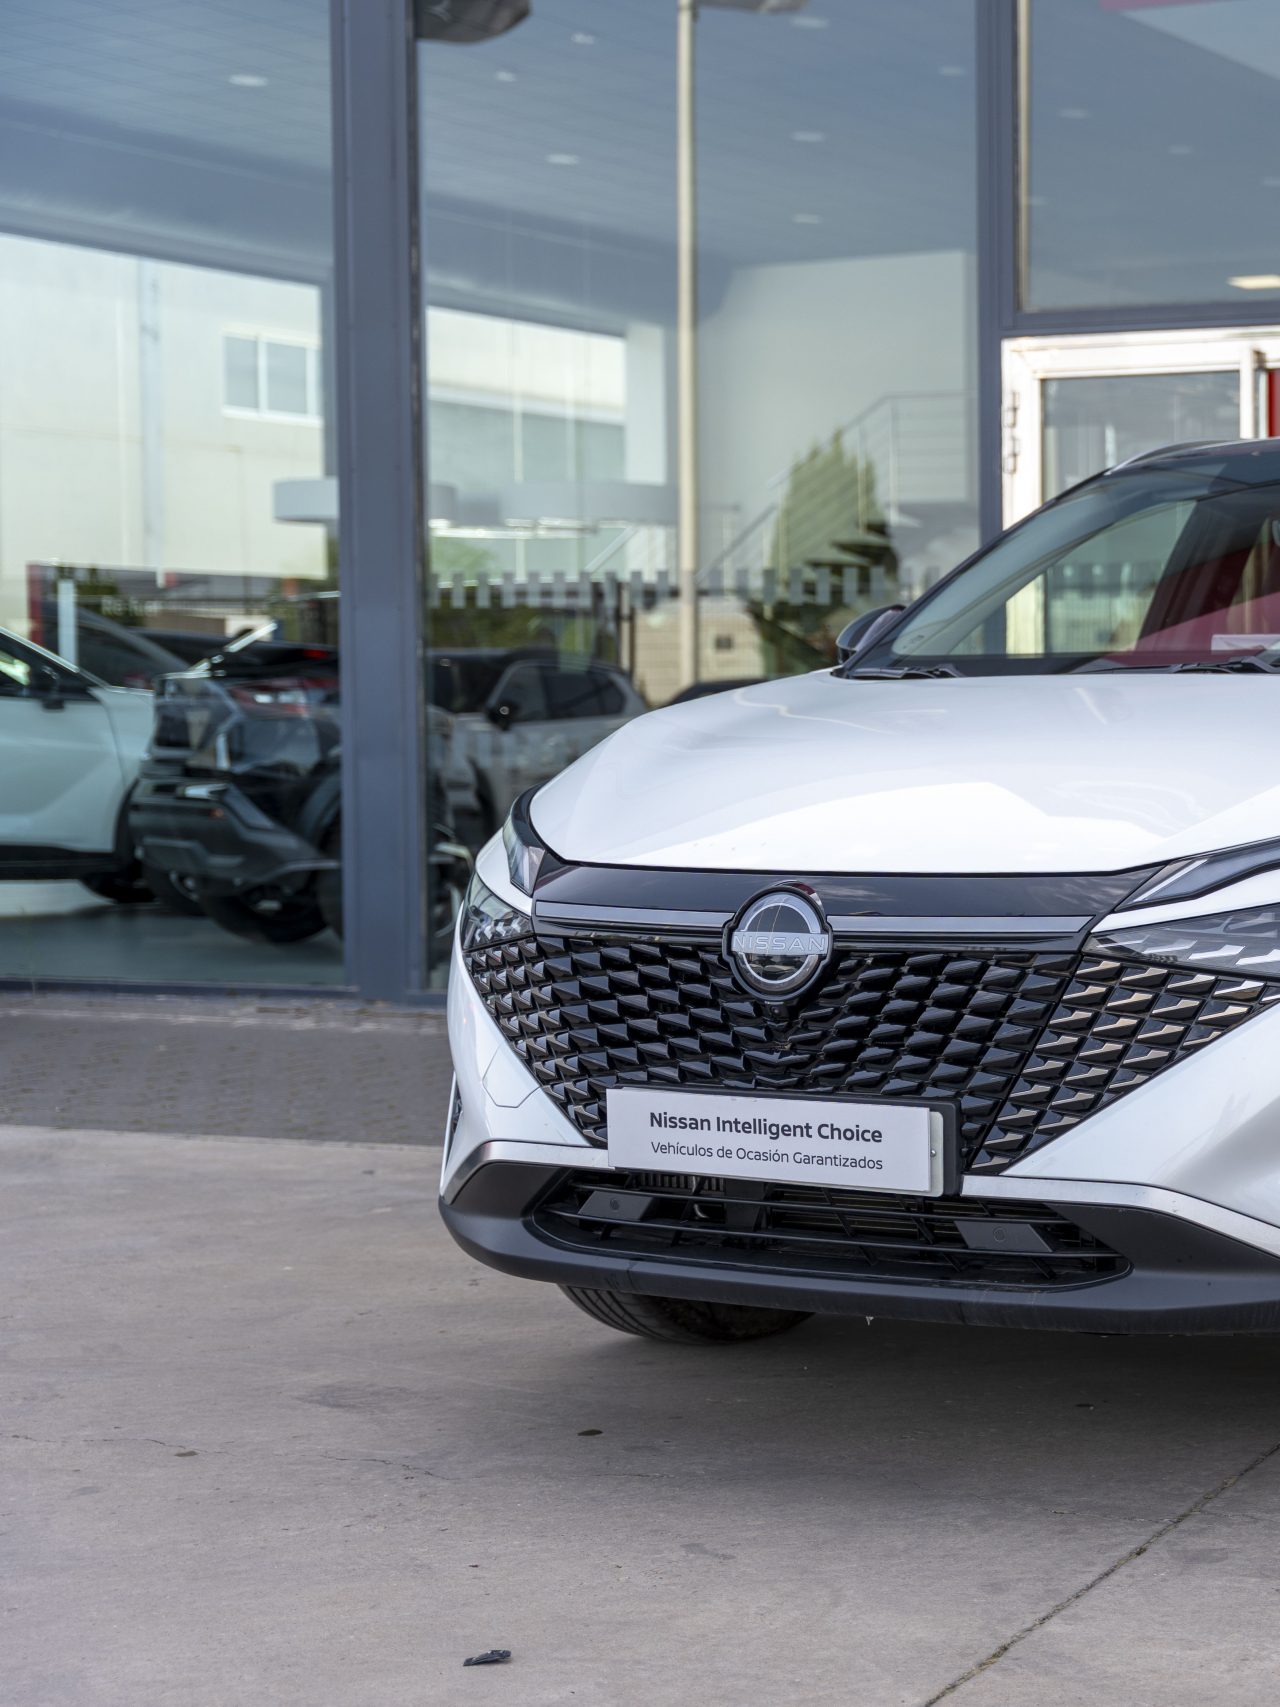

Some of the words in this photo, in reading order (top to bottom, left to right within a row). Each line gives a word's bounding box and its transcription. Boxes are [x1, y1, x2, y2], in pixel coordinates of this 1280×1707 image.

[733, 935, 826, 952] NISSAN
[650, 1112, 711, 1132] Nissan
[716, 1117, 813, 1140] Intelligent
[817, 1123, 883, 1143] Choice
[651, 1141, 713, 1158] Vehículos
[716, 1146, 733, 1159] de
[736, 1148, 789, 1163] Ocasión
[792, 1152, 883, 1170] Garantizados
